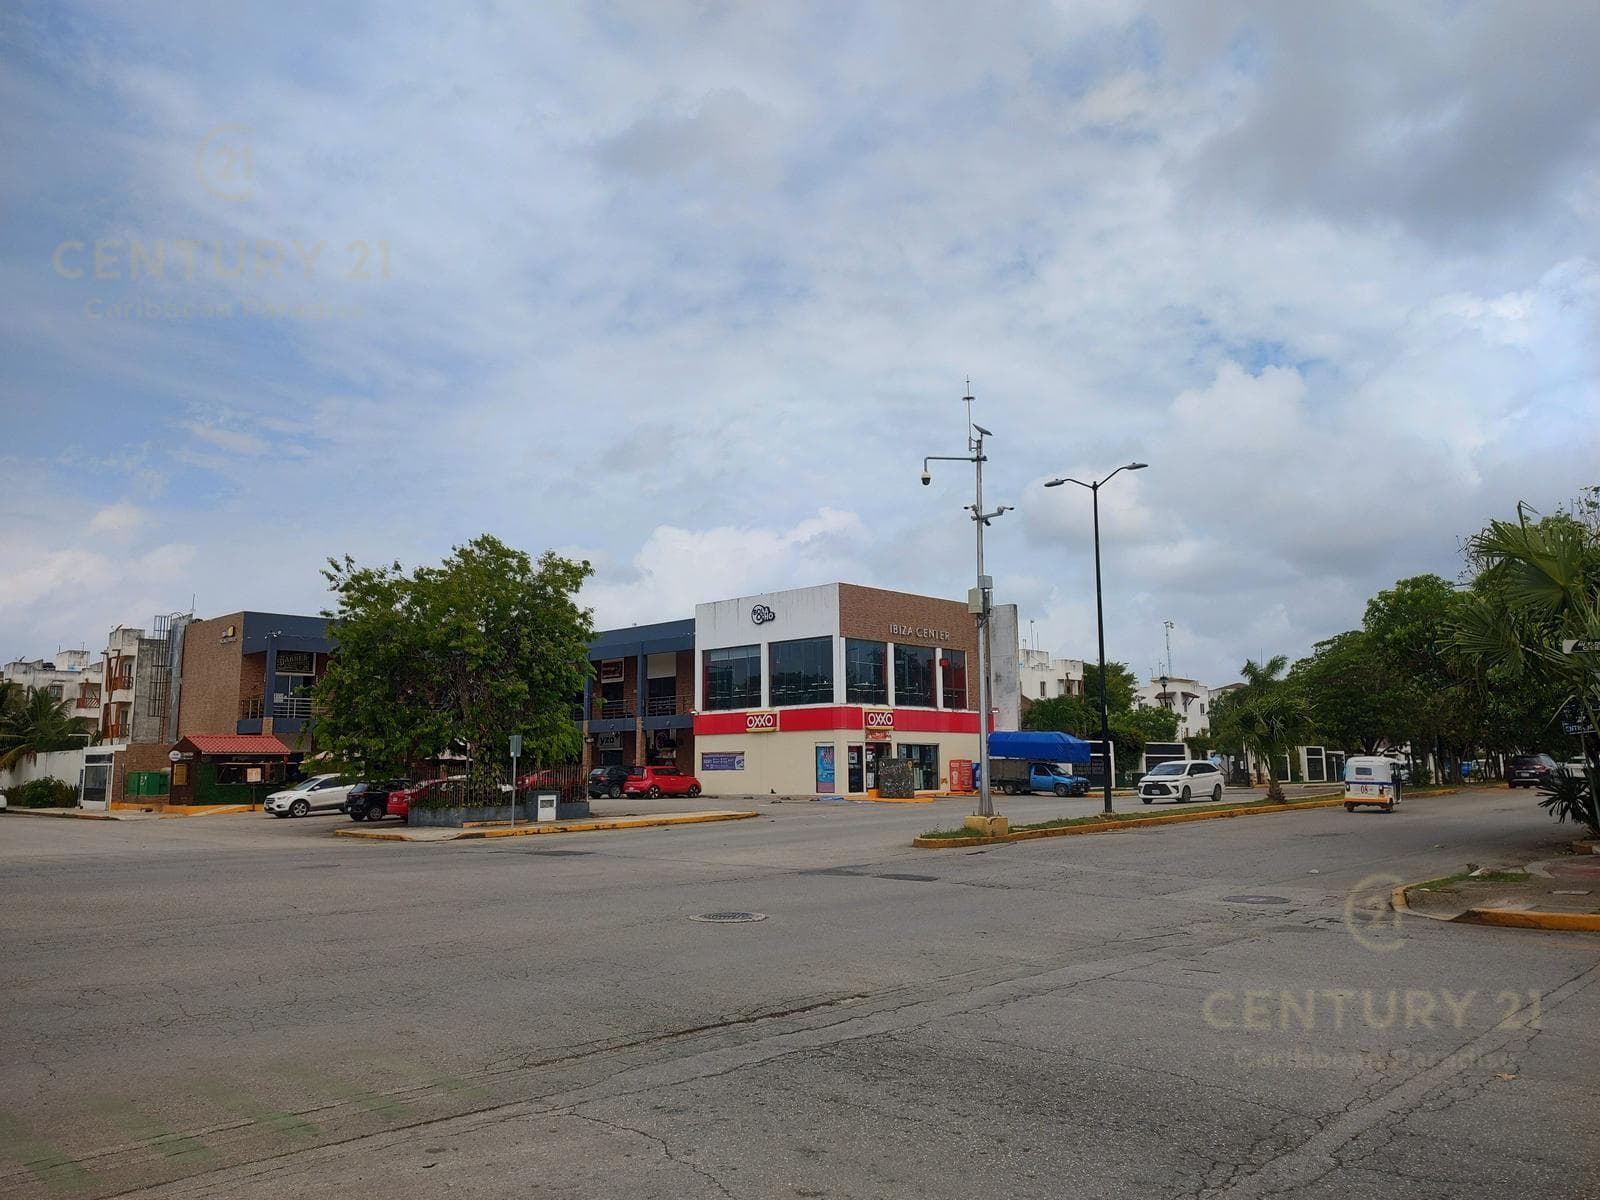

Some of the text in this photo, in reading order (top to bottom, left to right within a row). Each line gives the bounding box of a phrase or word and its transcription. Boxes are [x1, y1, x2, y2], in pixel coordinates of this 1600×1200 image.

[889, 624, 950, 641] IBIZA CENTER
[746, 713, 773, 728] OXXO
[868, 711, 894, 727] OXXO
